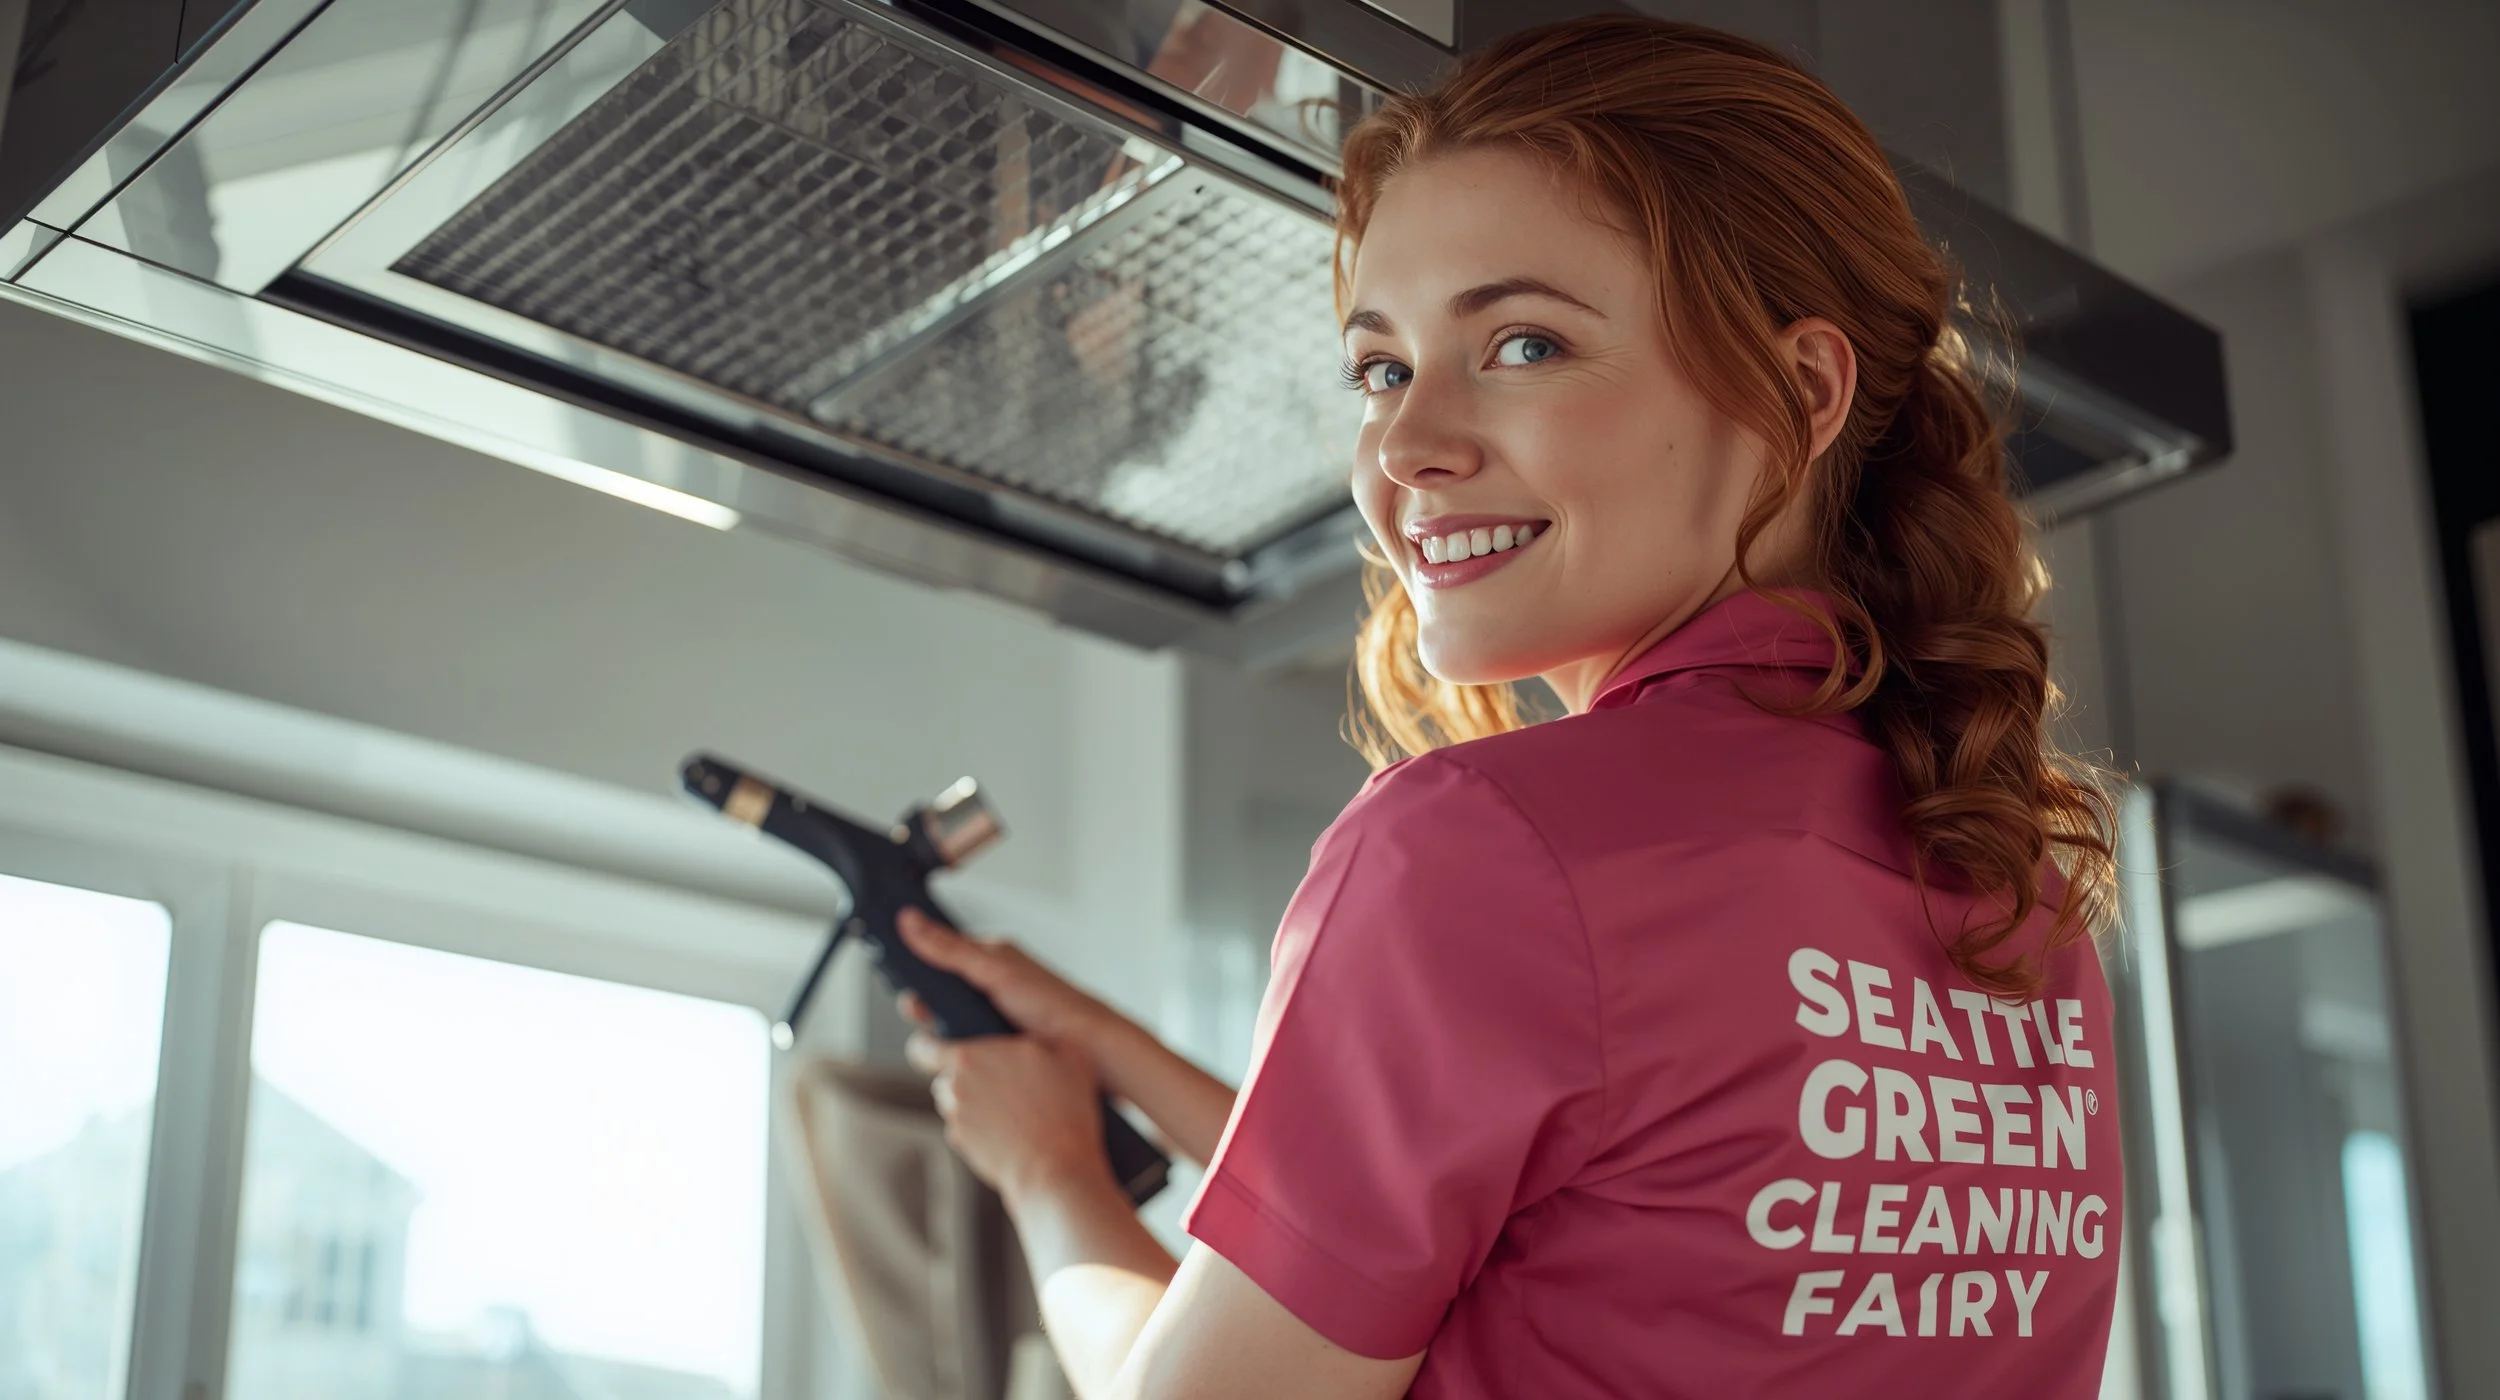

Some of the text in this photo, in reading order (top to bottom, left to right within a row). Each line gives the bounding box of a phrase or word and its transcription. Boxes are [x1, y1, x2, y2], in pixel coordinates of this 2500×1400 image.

[1788, 947, 2094, 1069] SEATTLE
[1746, 1178, 2107, 1259] CLEANING
[1782, 1269, 2050, 1337] FAIRY
